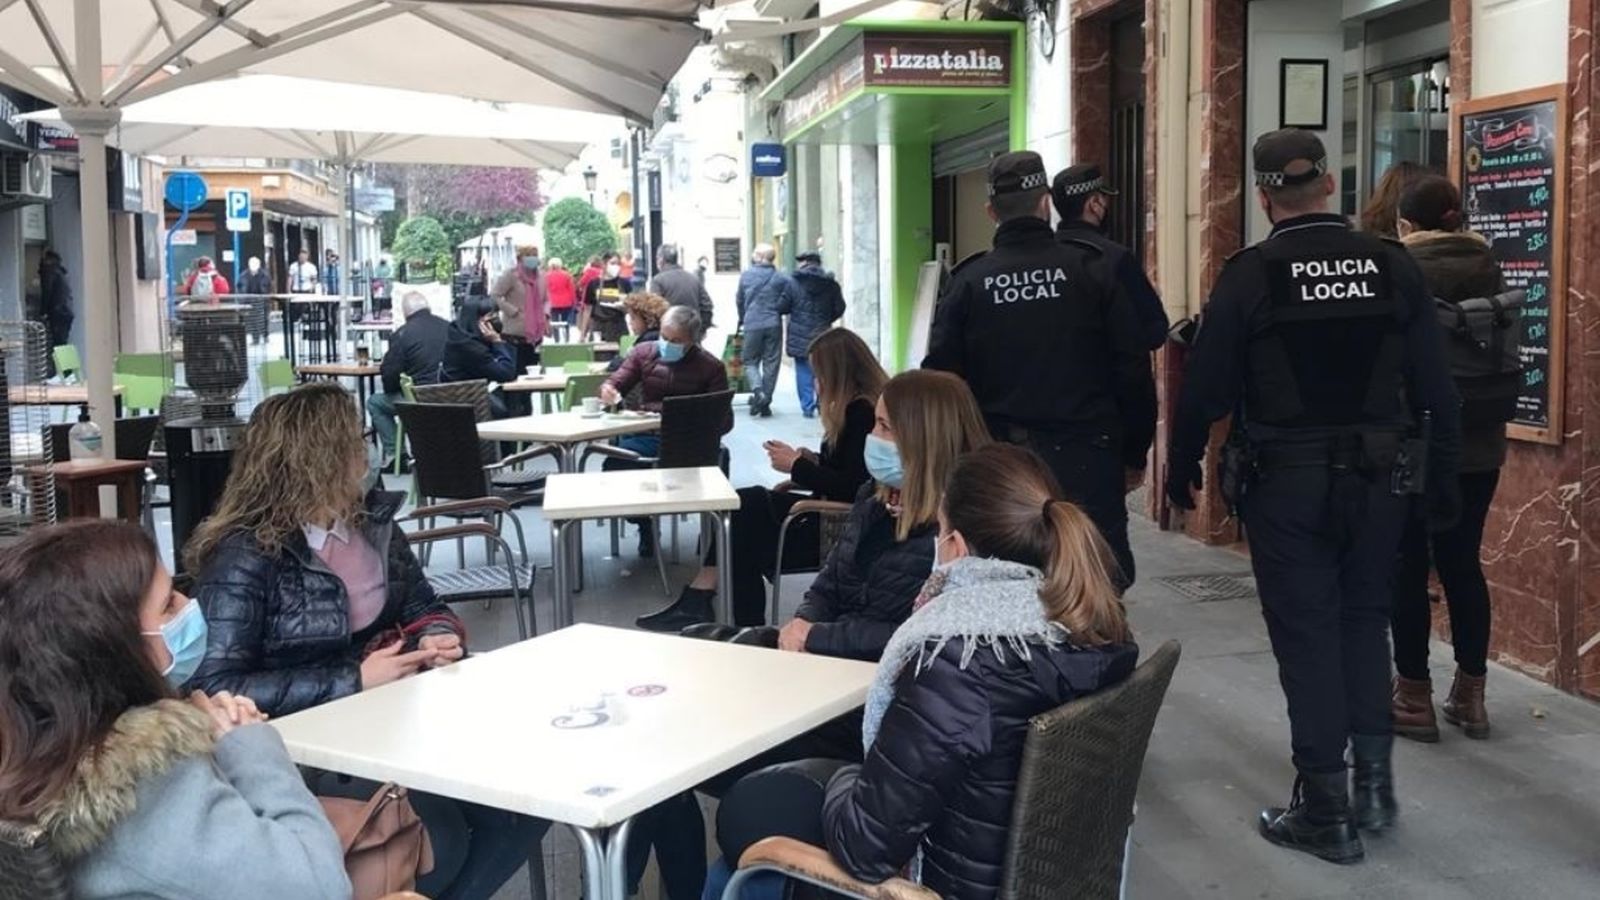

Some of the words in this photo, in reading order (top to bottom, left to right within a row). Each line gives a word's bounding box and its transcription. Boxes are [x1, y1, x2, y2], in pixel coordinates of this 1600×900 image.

[873, 47, 1003, 74] pizzatalia
[232, 192, 246, 218] P
[984, 268, 1067, 290] POLICIA
[1291, 259, 1379, 278] POLICIA
[994, 283, 1060, 304] LOCAL
[1301, 281, 1376, 301] LOCAL
